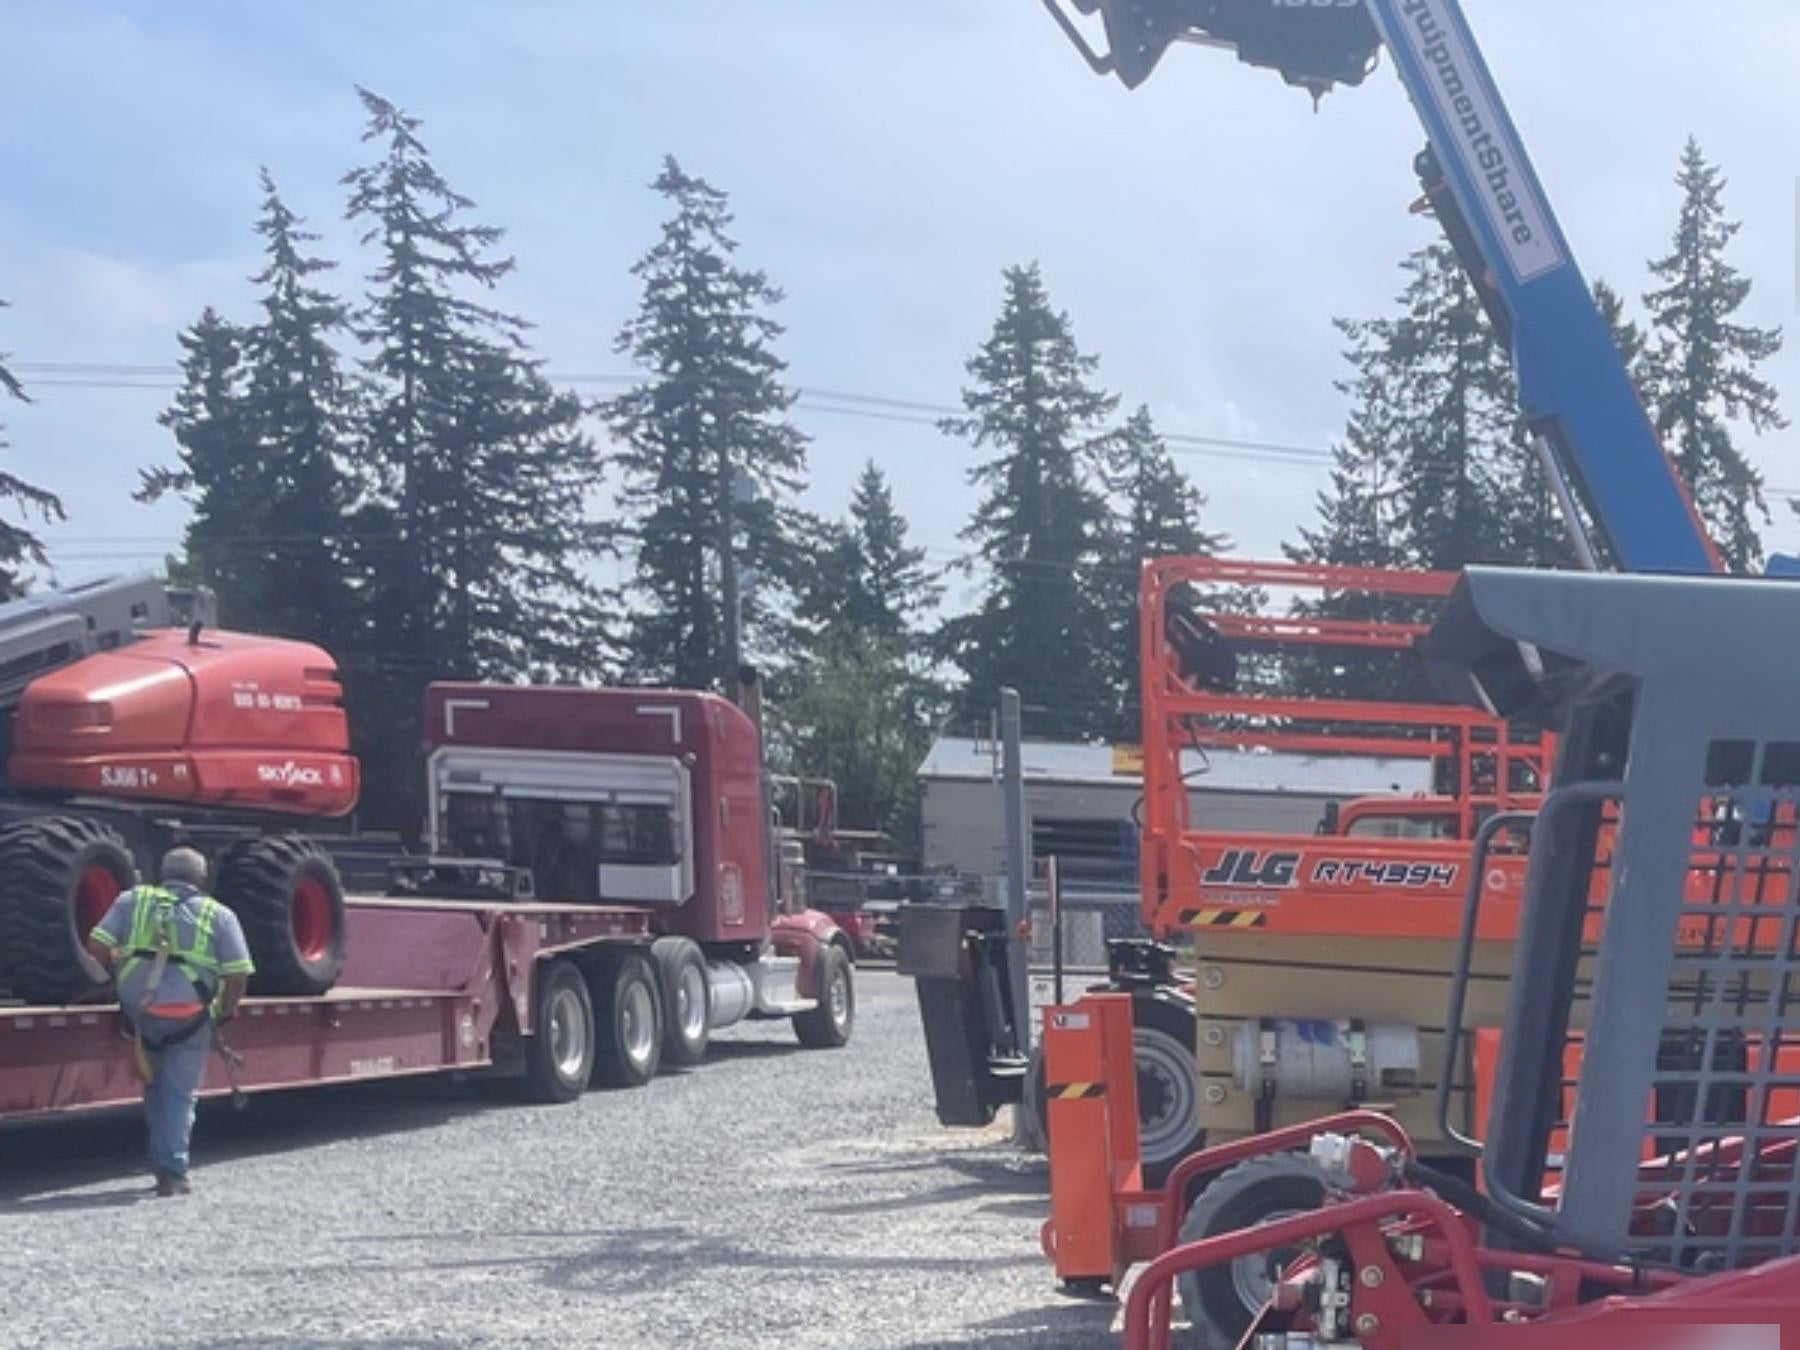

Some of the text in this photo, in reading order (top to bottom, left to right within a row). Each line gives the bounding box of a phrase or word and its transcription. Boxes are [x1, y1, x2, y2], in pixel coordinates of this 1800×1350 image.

[1403, 0, 1533, 247] quipmentShare
[257, 759, 323, 787] SKYJACK
[1201, 850, 1303, 889] JLG
